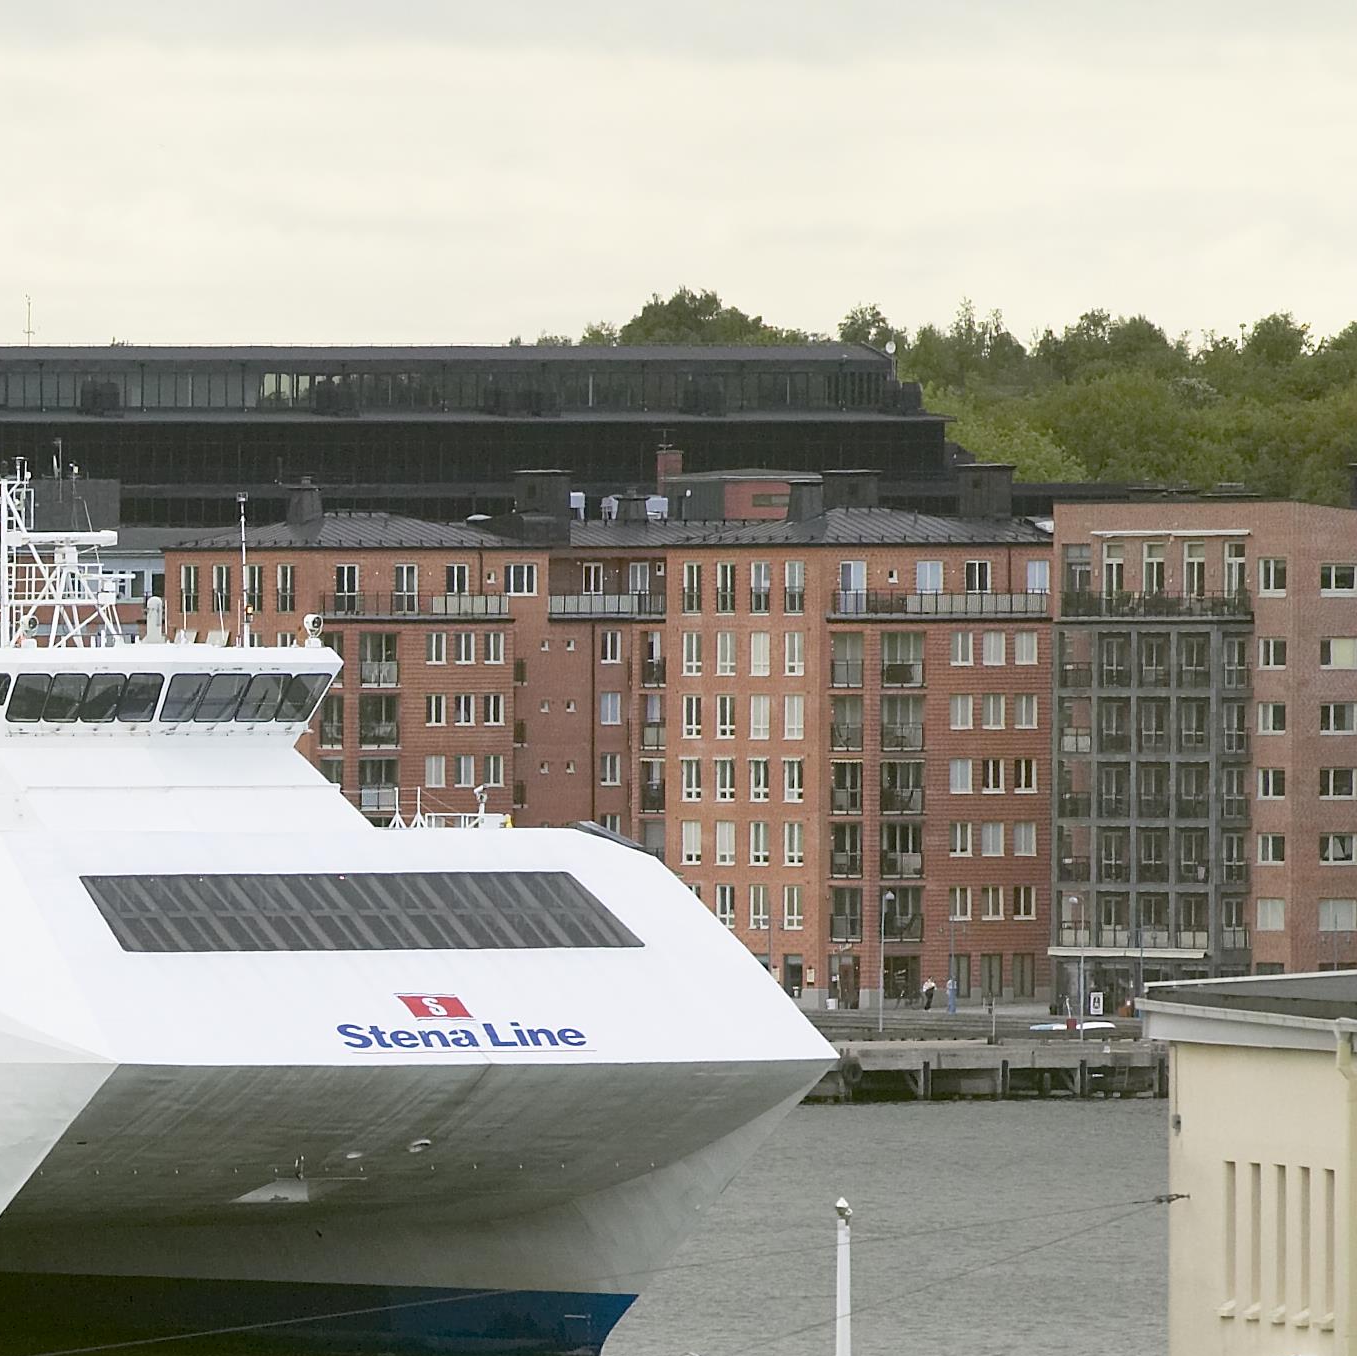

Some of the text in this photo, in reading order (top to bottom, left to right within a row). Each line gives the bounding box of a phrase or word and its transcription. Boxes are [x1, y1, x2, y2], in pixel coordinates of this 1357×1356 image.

[422, 997, 448, 1016] S
[336, 1022, 587, 1049] Stena Line
